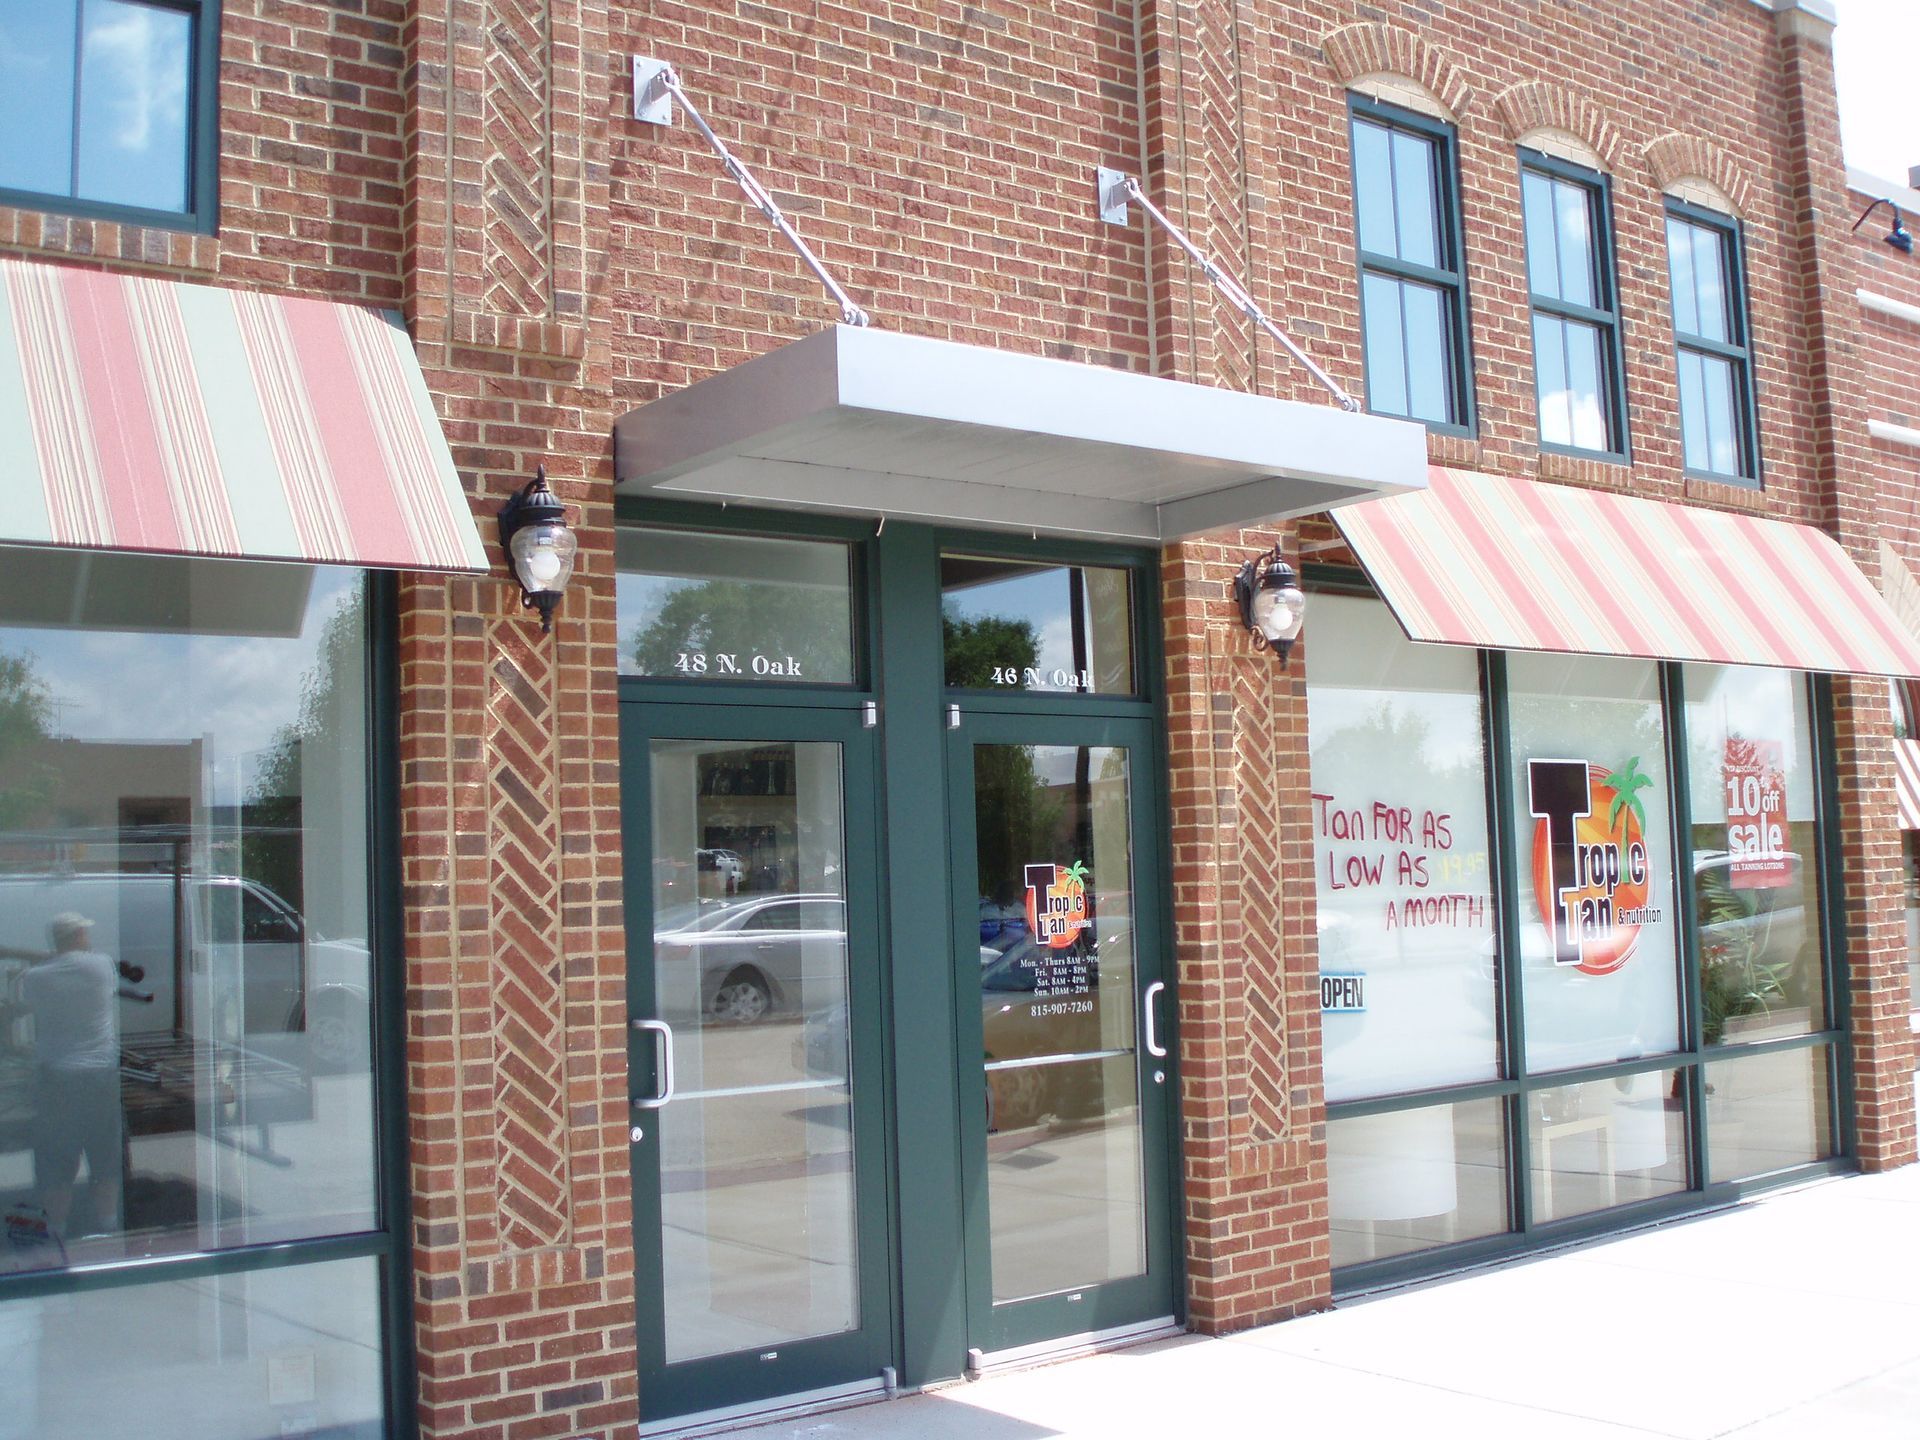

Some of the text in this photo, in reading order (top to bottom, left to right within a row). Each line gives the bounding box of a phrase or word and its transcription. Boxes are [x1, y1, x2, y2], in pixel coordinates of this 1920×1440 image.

[674, 653, 803, 676] 48 N. Oak
[990, 667, 1094, 687] 46 N. Oak
[1762, 790, 1780, 813] off
[1312, 794, 1452, 849] Tan FOR AS
[1728, 813, 1784, 862] sale
[1330, 851, 1385, 889] LOW
[1398, 851, 1430, 888] AS
[1386, 901, 1398, 931] A
[1626, 907, 1663, 925] nutrition
[1019, 959, 1038, 968] Mon.
[1044, 957, 1066, 967] Thurs
[1035, 968, 1048, 977] Fri.
[1053, 967, 1067, 976] 8AM
[1034, 988, 1049, 997] Sun.
[1037, 978, 1050, 987] Sat.
[1321, 977, 1364, 1009] OPEN
[1031, 1000, 1093, 1017] 815-907-7260
